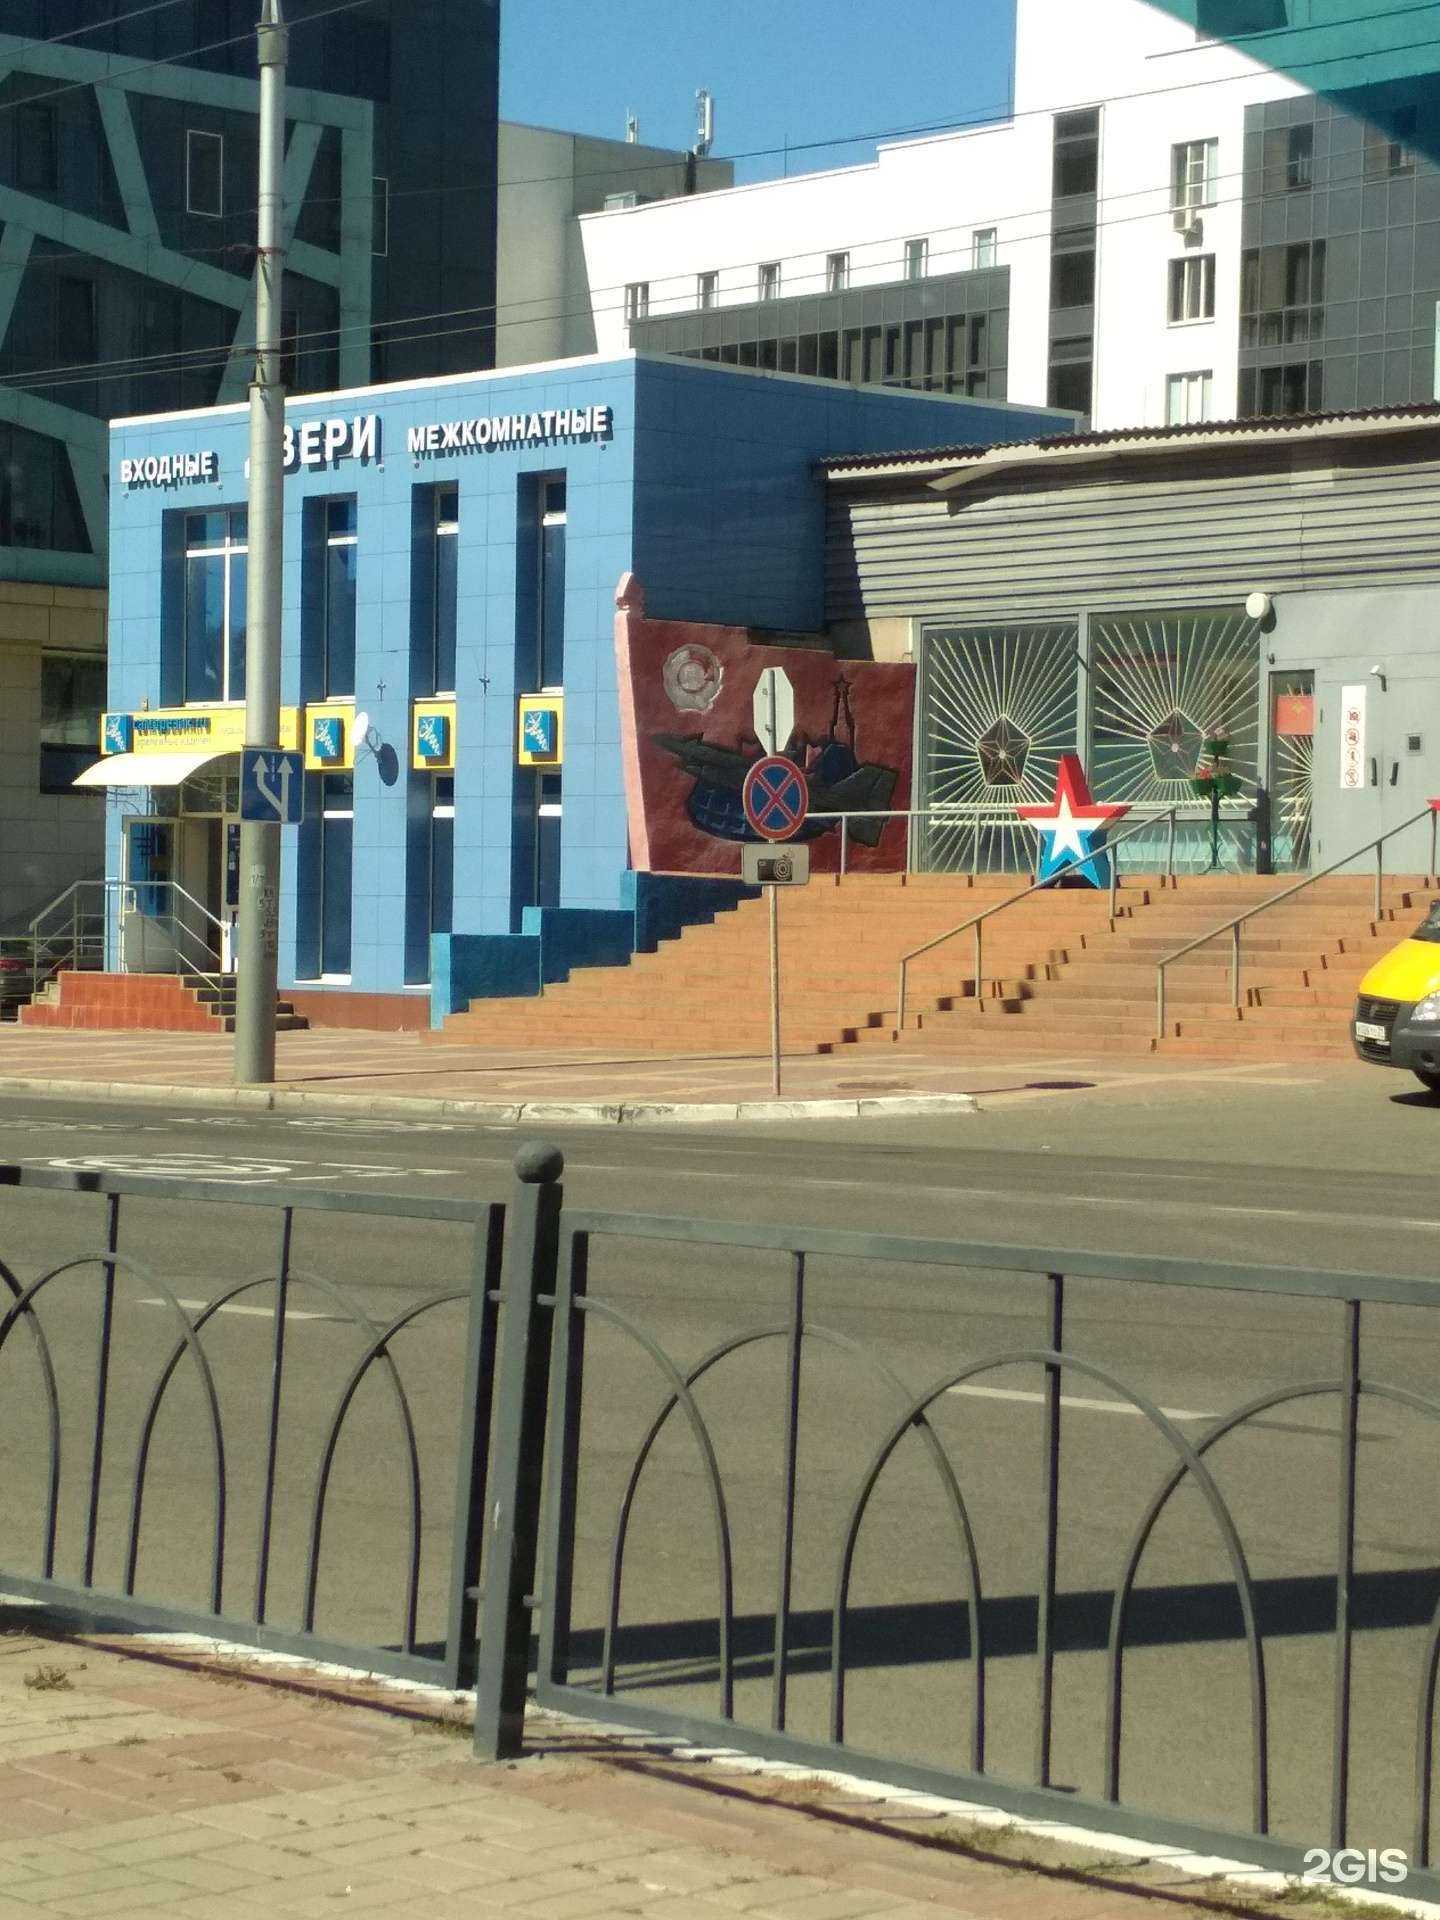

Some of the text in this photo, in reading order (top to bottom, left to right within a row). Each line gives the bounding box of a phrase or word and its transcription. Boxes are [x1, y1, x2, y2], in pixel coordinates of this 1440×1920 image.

[120, 405, 608, 485] ВХОДНЫЕ ВЕРИ МЕЖКОМНАТНЫЕ
